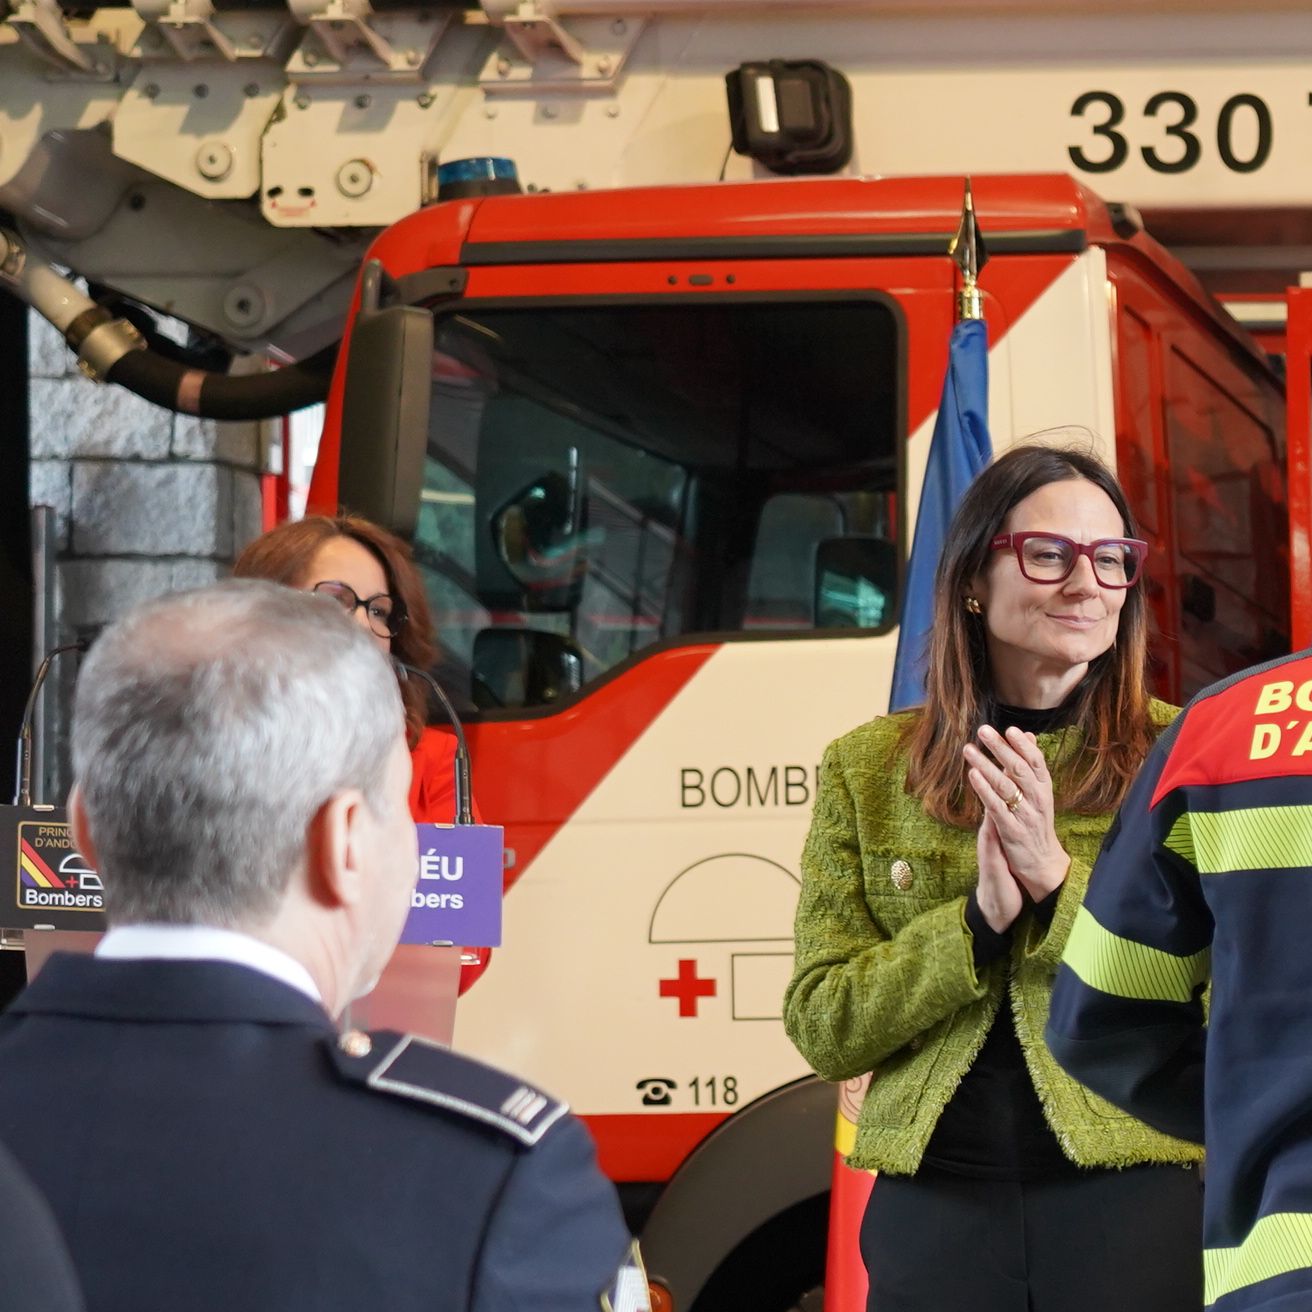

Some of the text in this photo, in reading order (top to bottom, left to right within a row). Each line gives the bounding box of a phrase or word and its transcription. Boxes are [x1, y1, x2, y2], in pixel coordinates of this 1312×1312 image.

[1067, 90, 1273, 174] 330
[680, 765, 820, 809] BOMB
[25, 888, 103, 908] Bombers
[688, 1076, 739, 1106] 118
